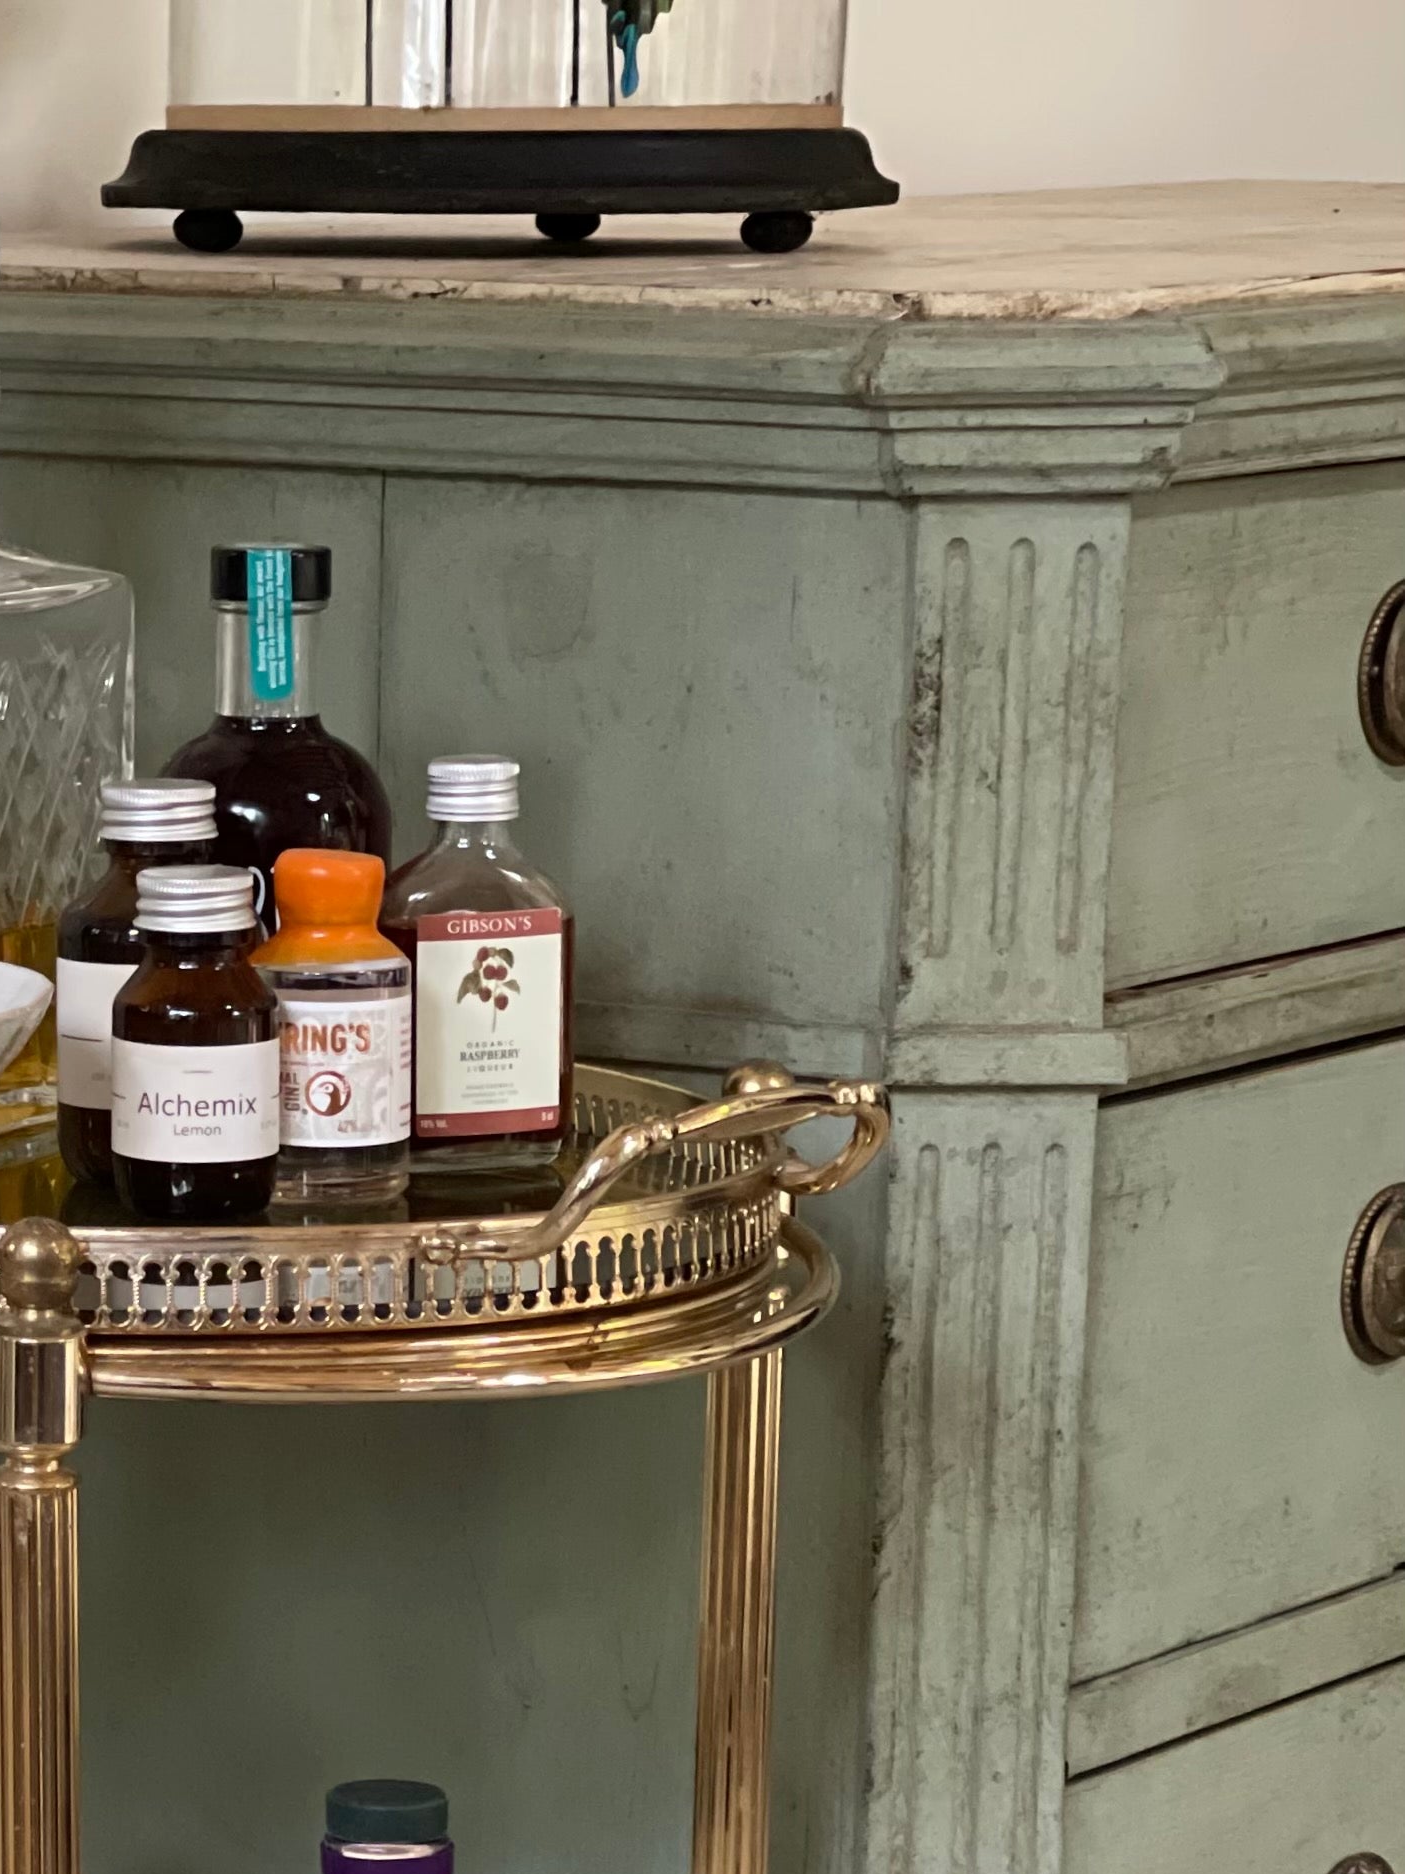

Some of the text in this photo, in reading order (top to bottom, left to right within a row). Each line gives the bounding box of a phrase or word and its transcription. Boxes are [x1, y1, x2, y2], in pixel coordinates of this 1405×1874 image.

[447, 915, 532, 934] GIBSON'S
[280, 1021, 371, 1054] RING'S
[459, 1048, 520, 1062] RASPBERRY
[137, 1091, 257, 1117] Alchemix
[173, 1124, 222, 1136] Lemon
